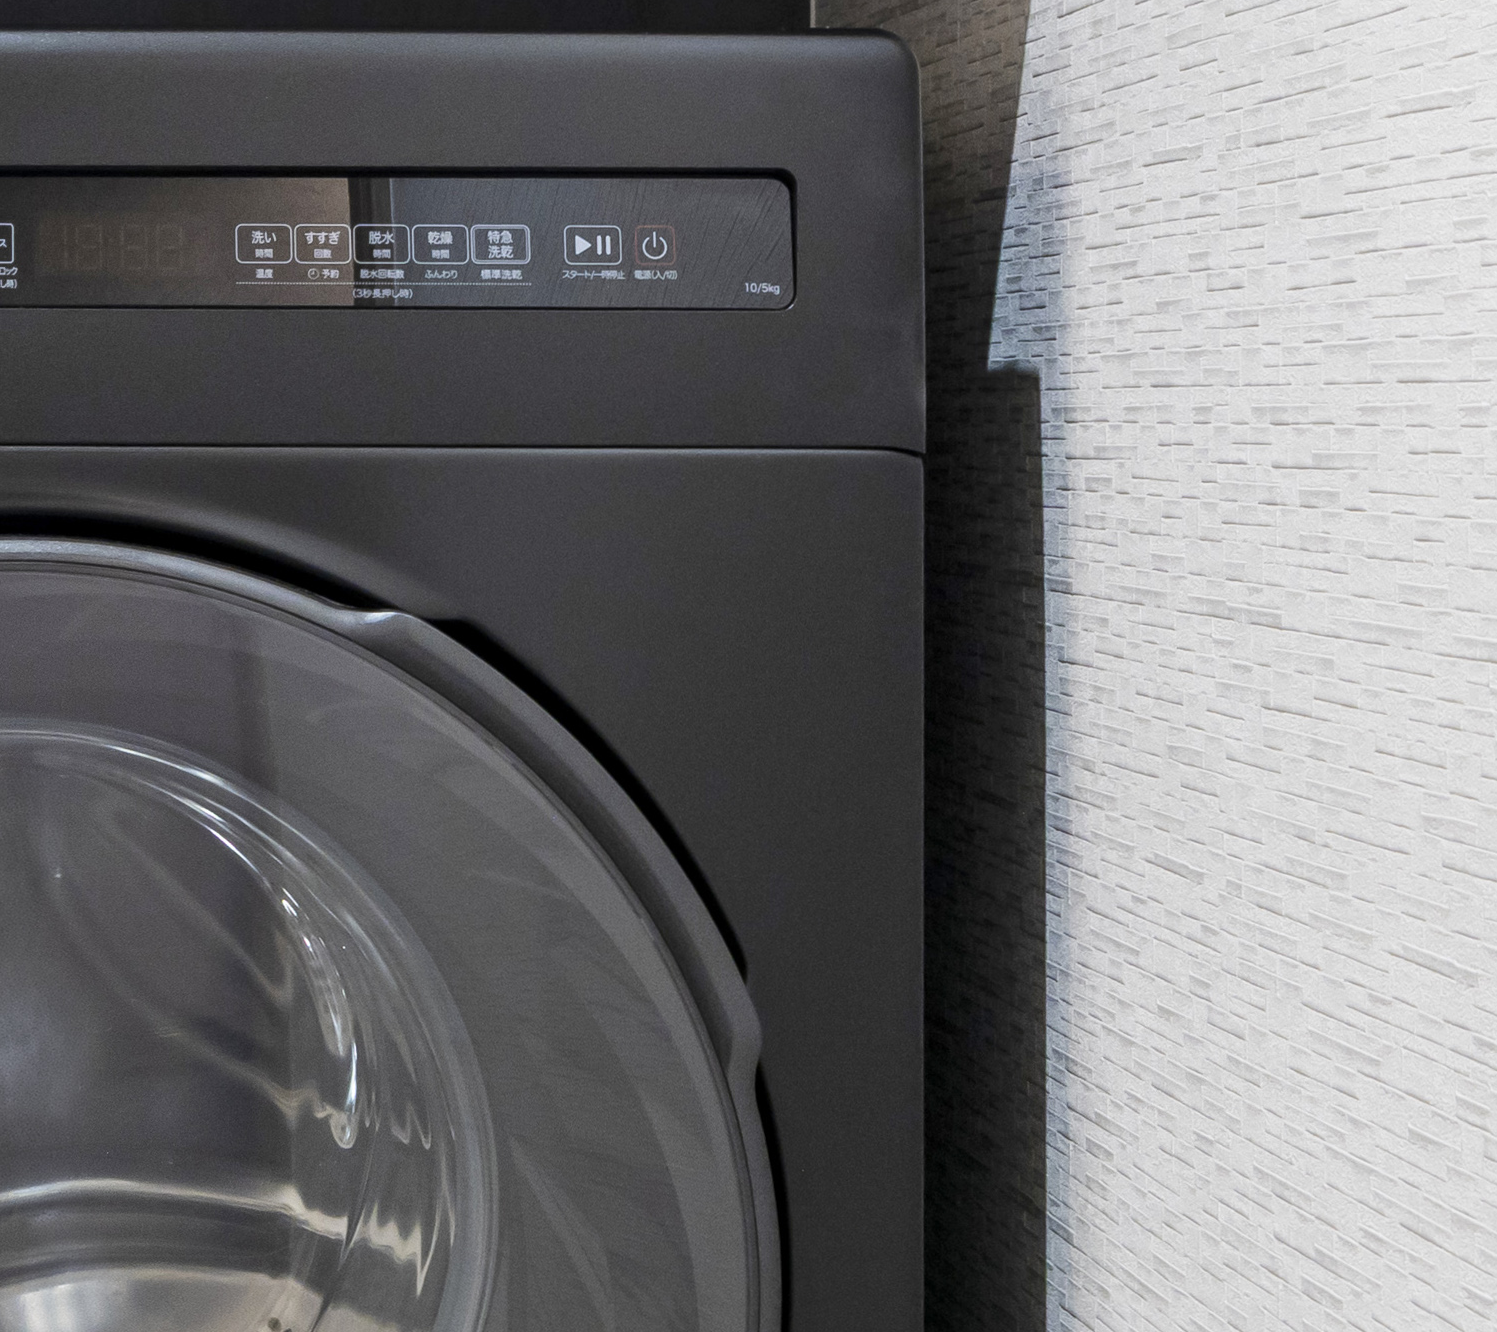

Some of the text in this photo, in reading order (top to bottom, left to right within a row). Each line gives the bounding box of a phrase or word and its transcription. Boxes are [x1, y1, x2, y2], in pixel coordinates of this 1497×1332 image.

[251, 231, 277, 244] 洗い
[304, 231, 339, 245] すすぎ
[368, 230, 395, 245] 脱水
[427, 230, 453, 245] 乾燥
[487, 230, 513, 244] 特急
[255, 248, 273, 259] 時間
[314, 248, 332, 259] 回数
[373, 248, 391, 259] 時間
[432, 249, 450, 259] 時間
[488, 245, 513, 258] 洗乾
[321, 269, 339, 279] 予約
[425, 269, 458, 279] ふんわり
[744, 282, 780, 294] 10/5kg
